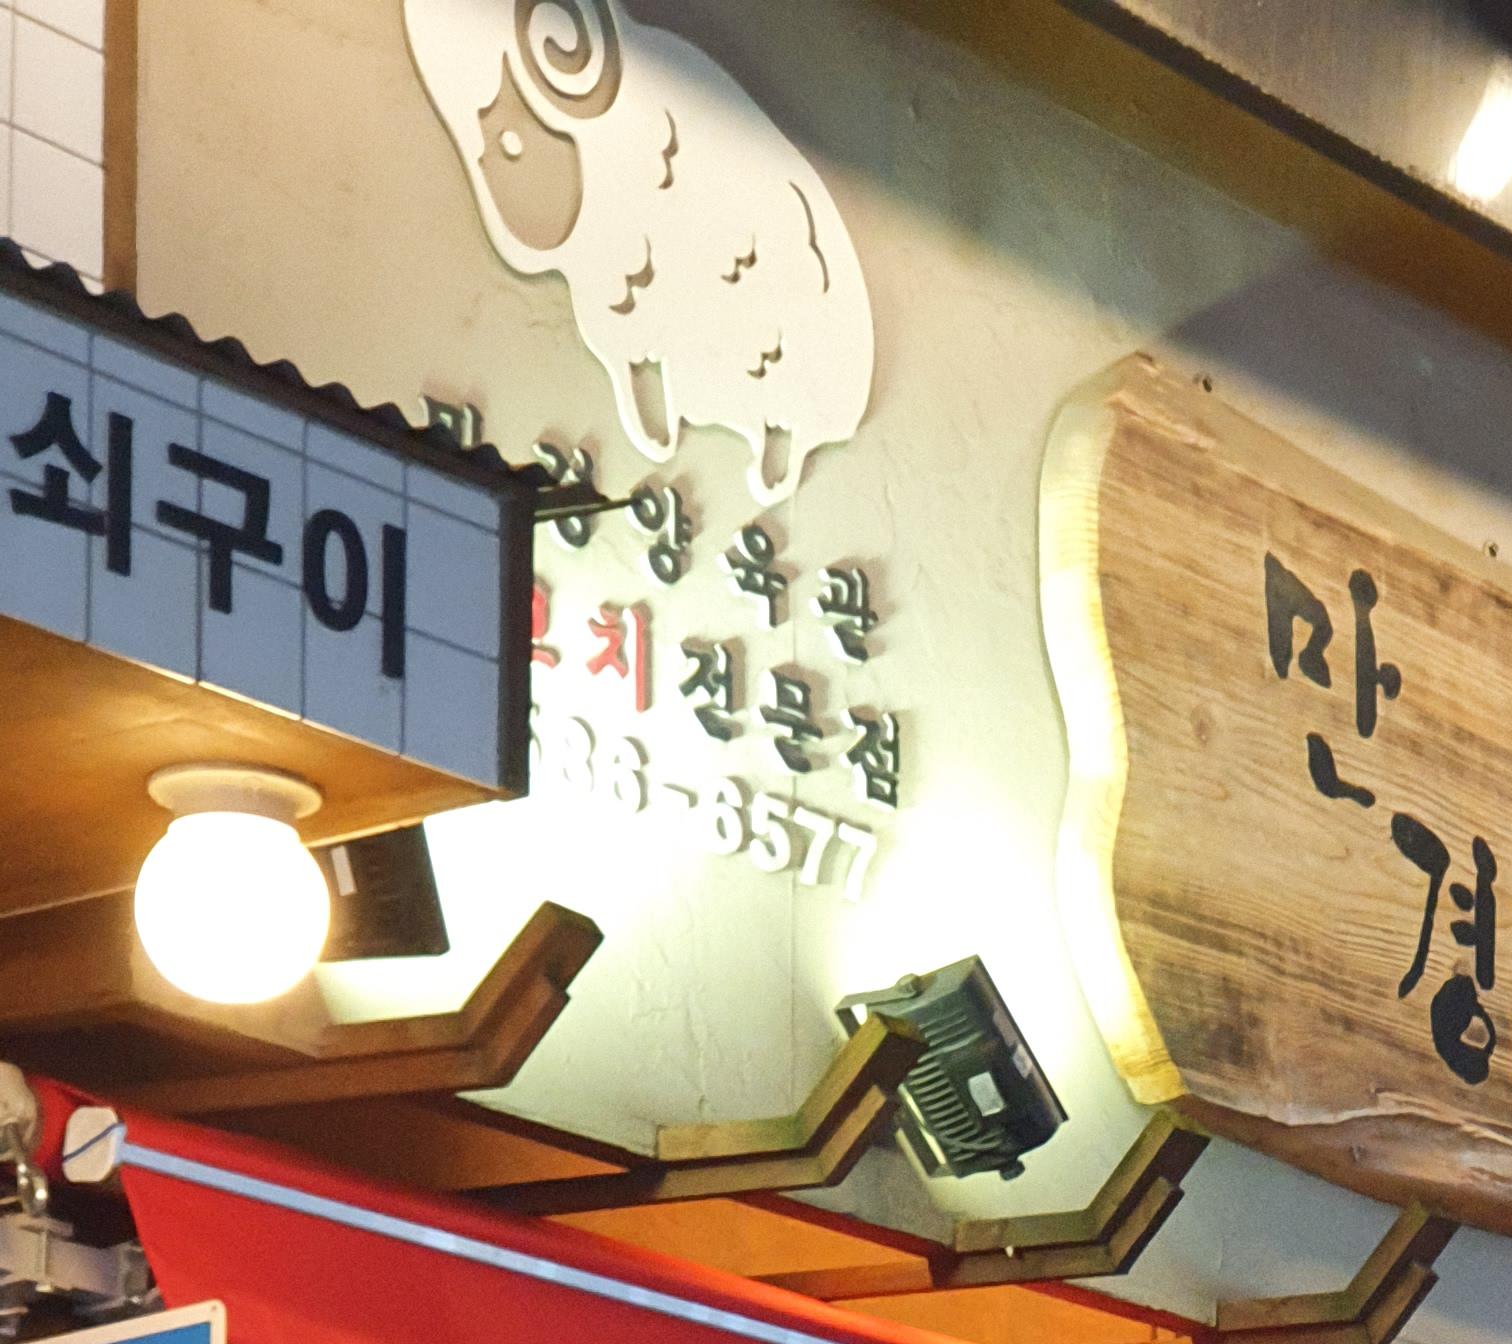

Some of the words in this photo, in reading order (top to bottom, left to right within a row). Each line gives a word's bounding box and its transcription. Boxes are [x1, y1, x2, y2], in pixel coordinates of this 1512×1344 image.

[9, 391, 407, 679] 쇠구이
[678, 642, 901, 812] 전문점
[1263, 550, 1498, 1086] 만경
